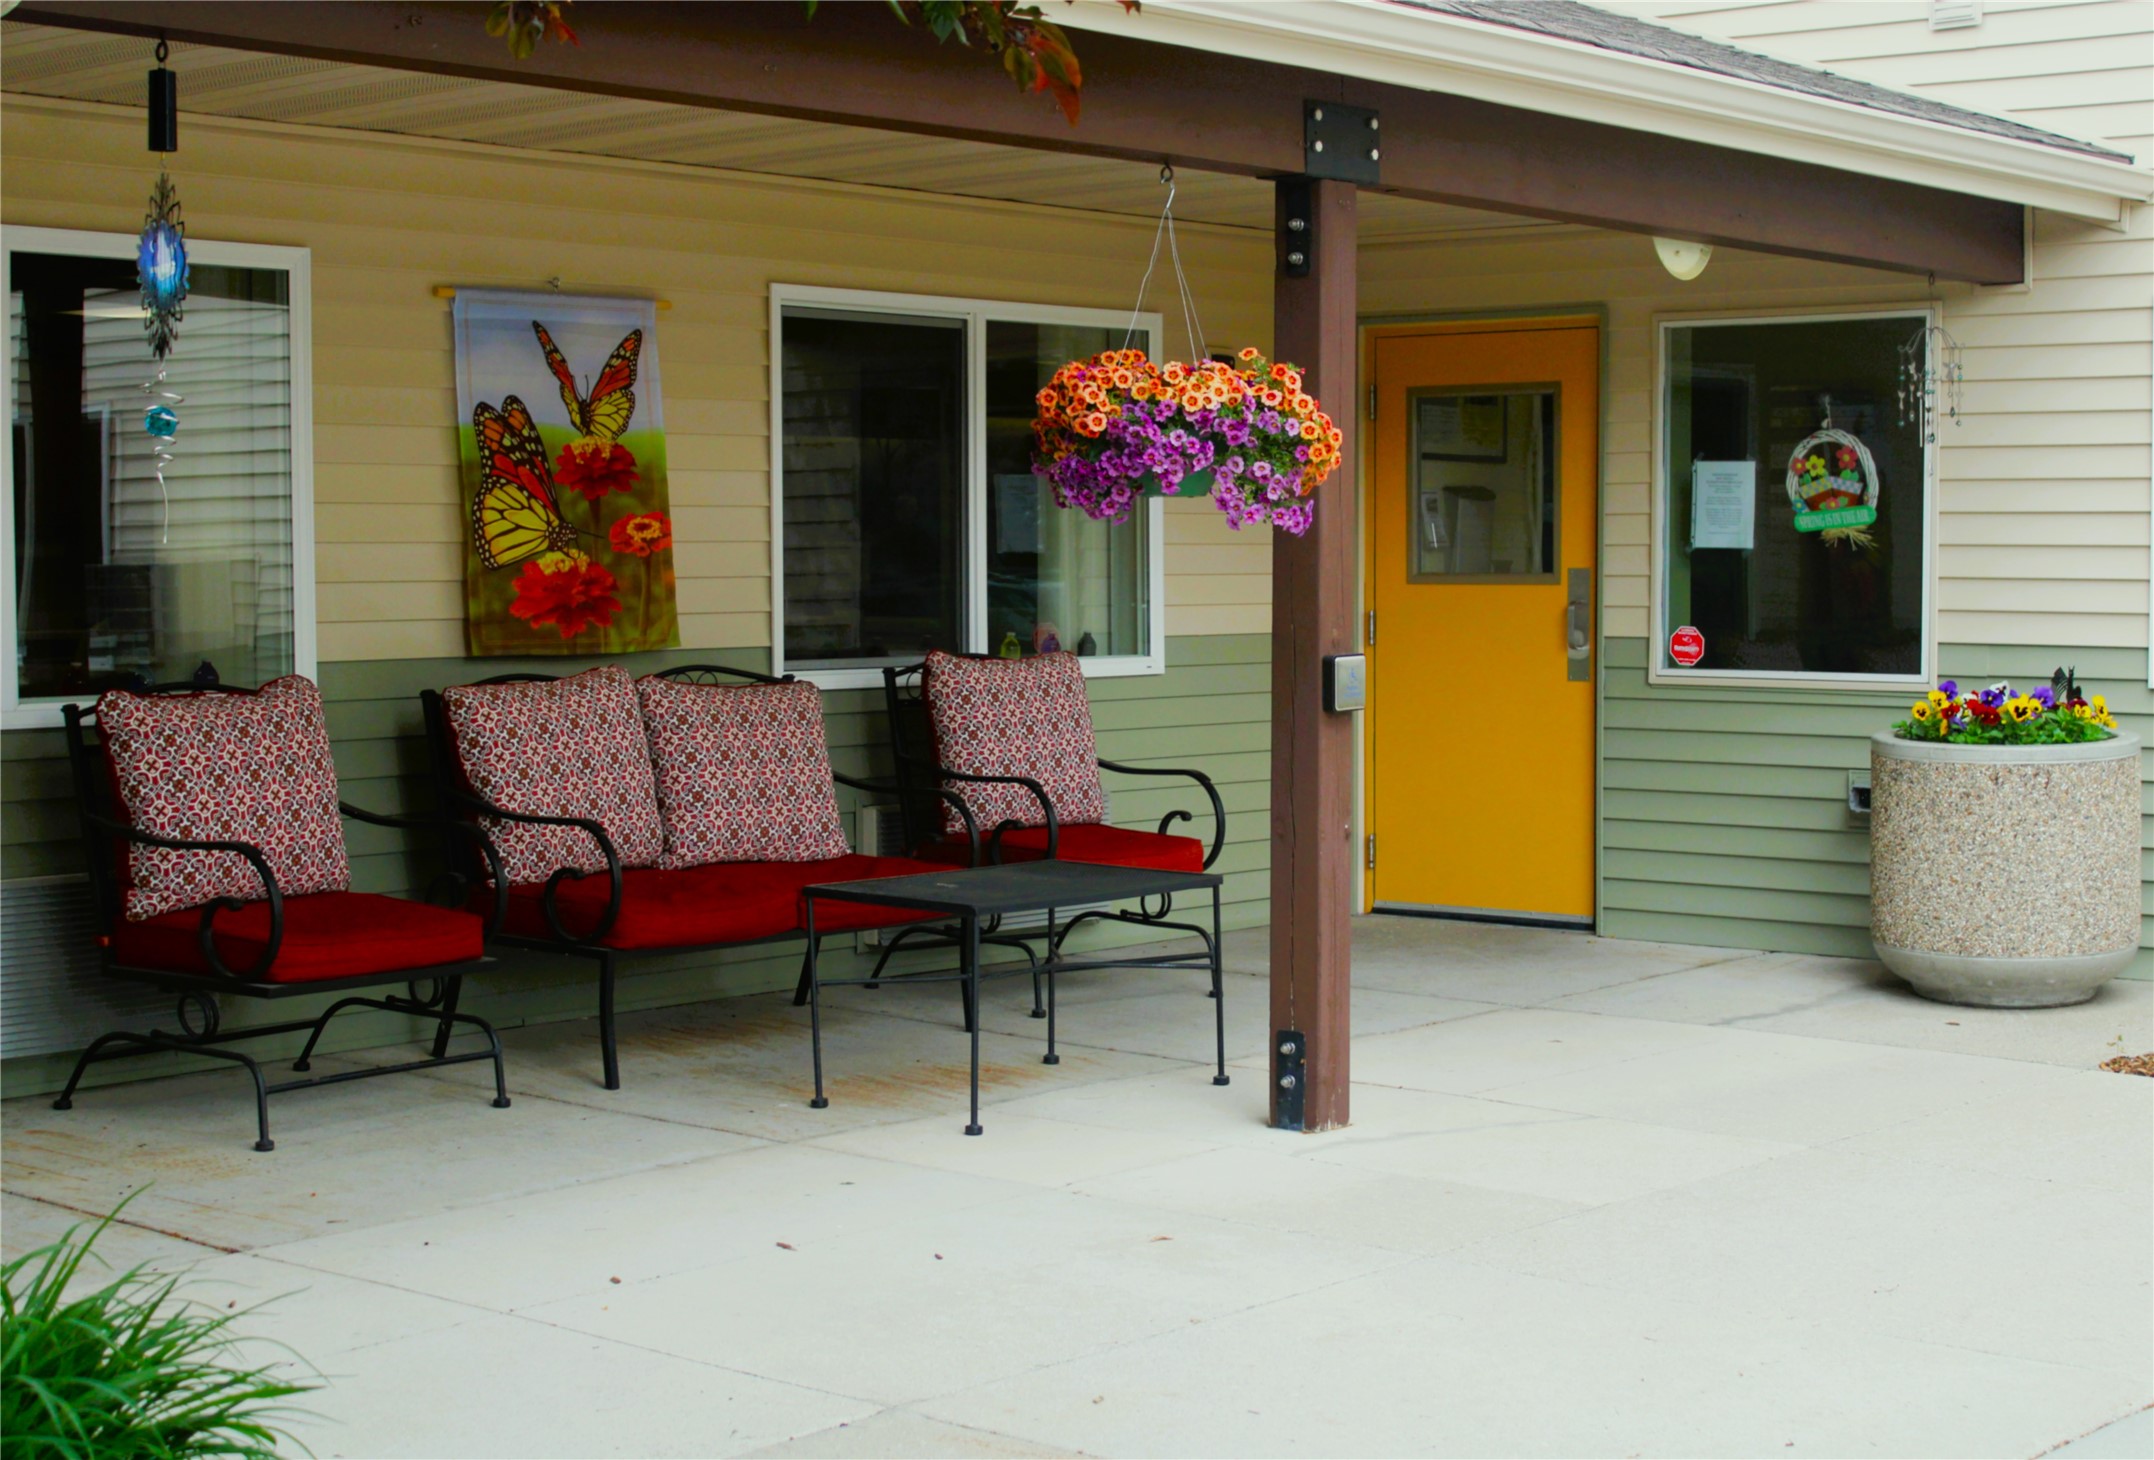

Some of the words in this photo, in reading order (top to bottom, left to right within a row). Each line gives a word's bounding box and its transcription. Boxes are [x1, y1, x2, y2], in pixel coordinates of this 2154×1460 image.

[1799, 515, 1825, 528] SPRING
[1841, 510, 1857, 524] THE
[1856, 509, 1870, 522] AIR
